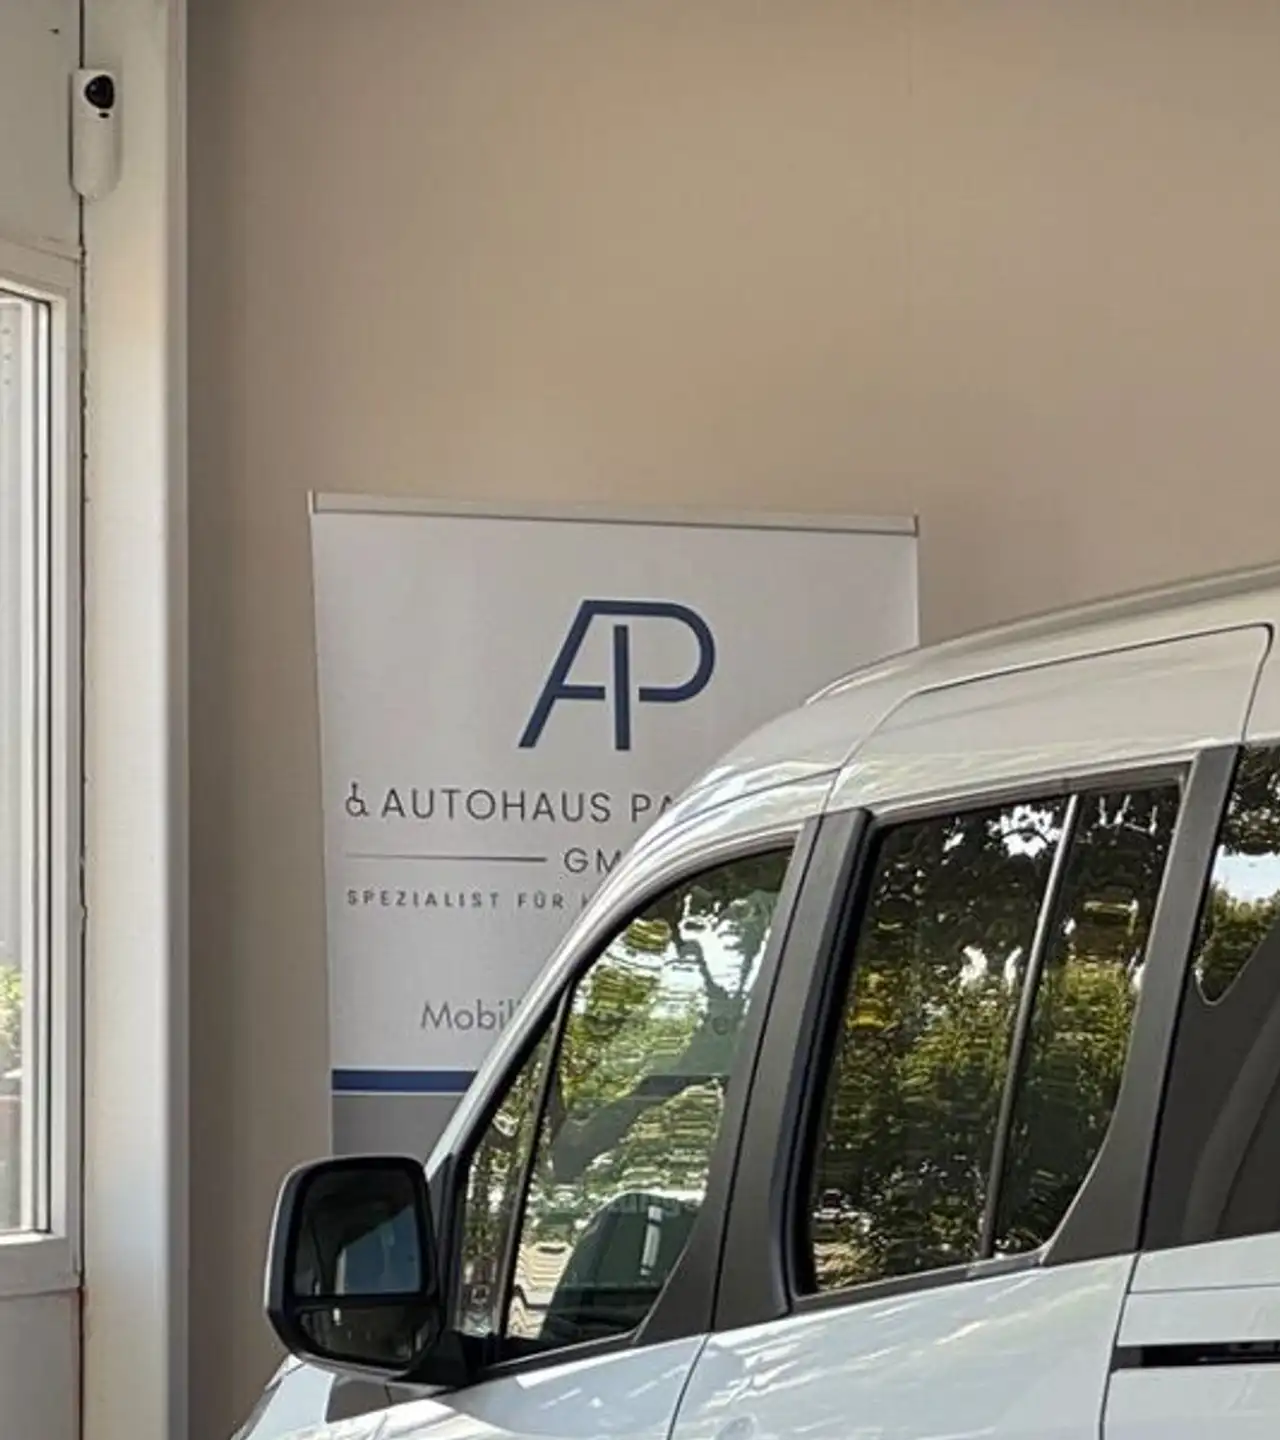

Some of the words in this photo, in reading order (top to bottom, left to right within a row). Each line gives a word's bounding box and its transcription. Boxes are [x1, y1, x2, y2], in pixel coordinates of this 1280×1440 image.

[518, 600, 715, 751] AP
[381, 788, 612, 823] AUTOHAUS
[347, 889, 499, 908] SPEZIALIST
[517, 891, 564, 909] FÜR
